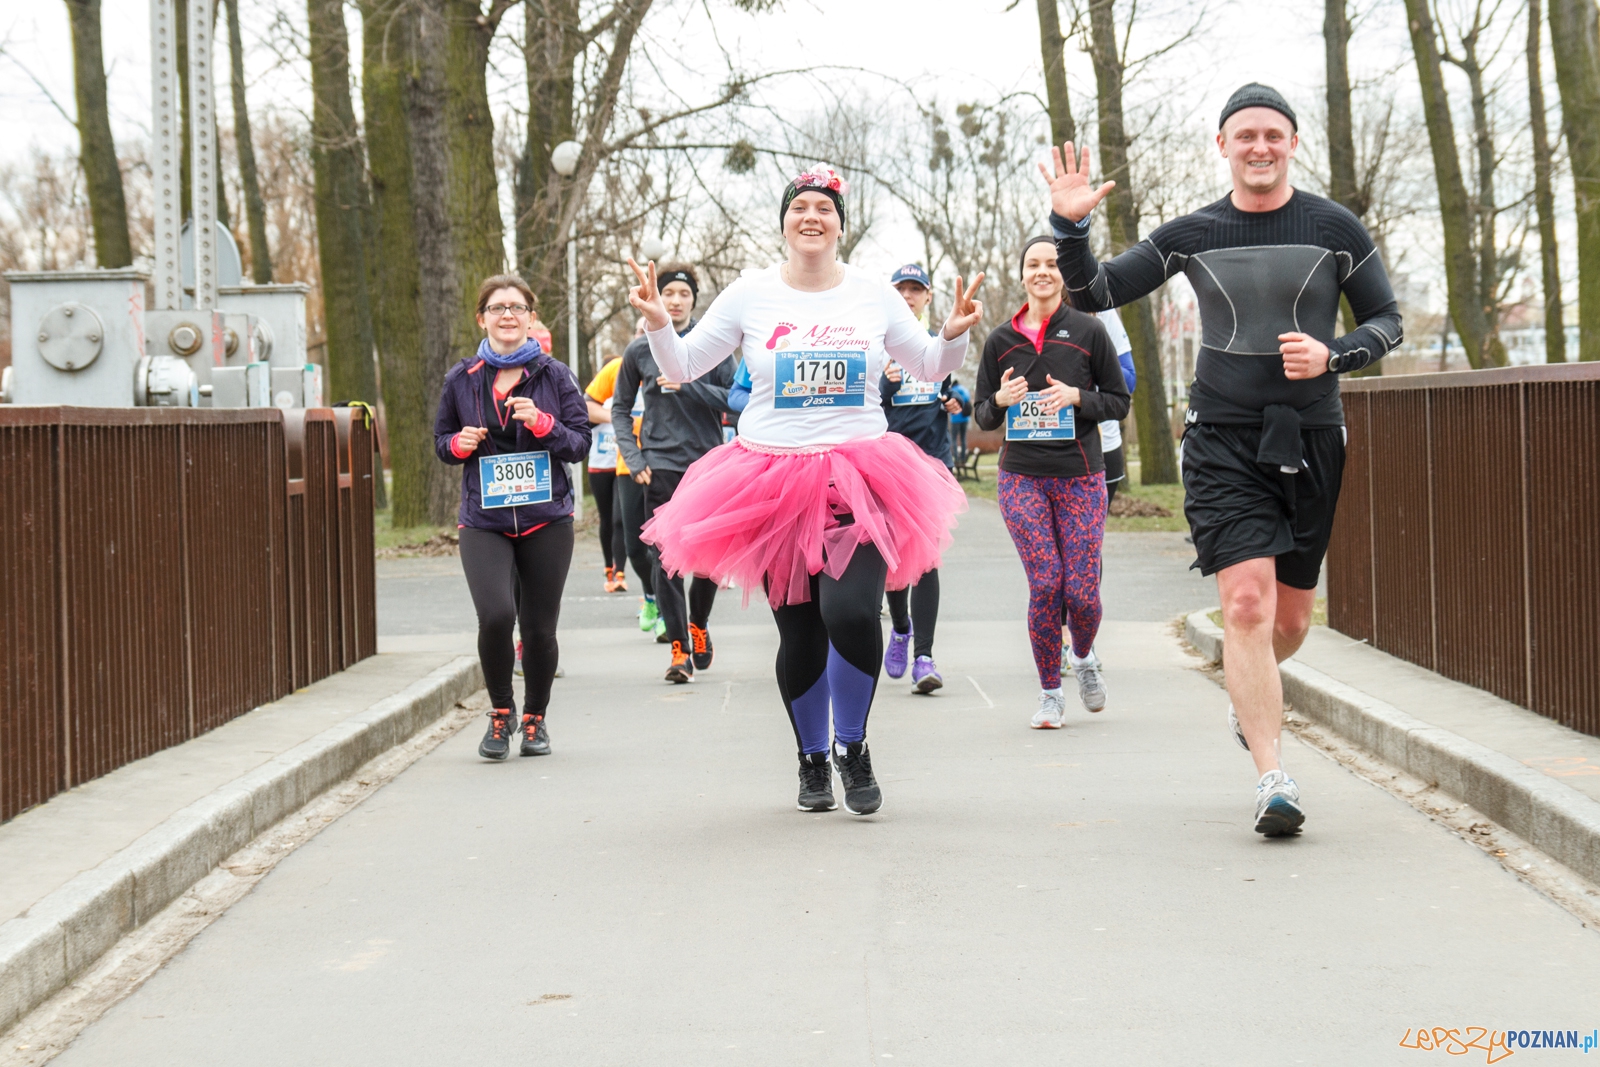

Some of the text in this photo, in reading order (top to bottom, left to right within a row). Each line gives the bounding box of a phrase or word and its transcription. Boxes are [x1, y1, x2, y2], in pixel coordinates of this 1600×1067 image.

[802, 324, 856, 339] Mamy
[810, 335, 870, 350] Biegamy
[797, 361, 846, 381] 1710
[495, 461, 535, 481] 3806
